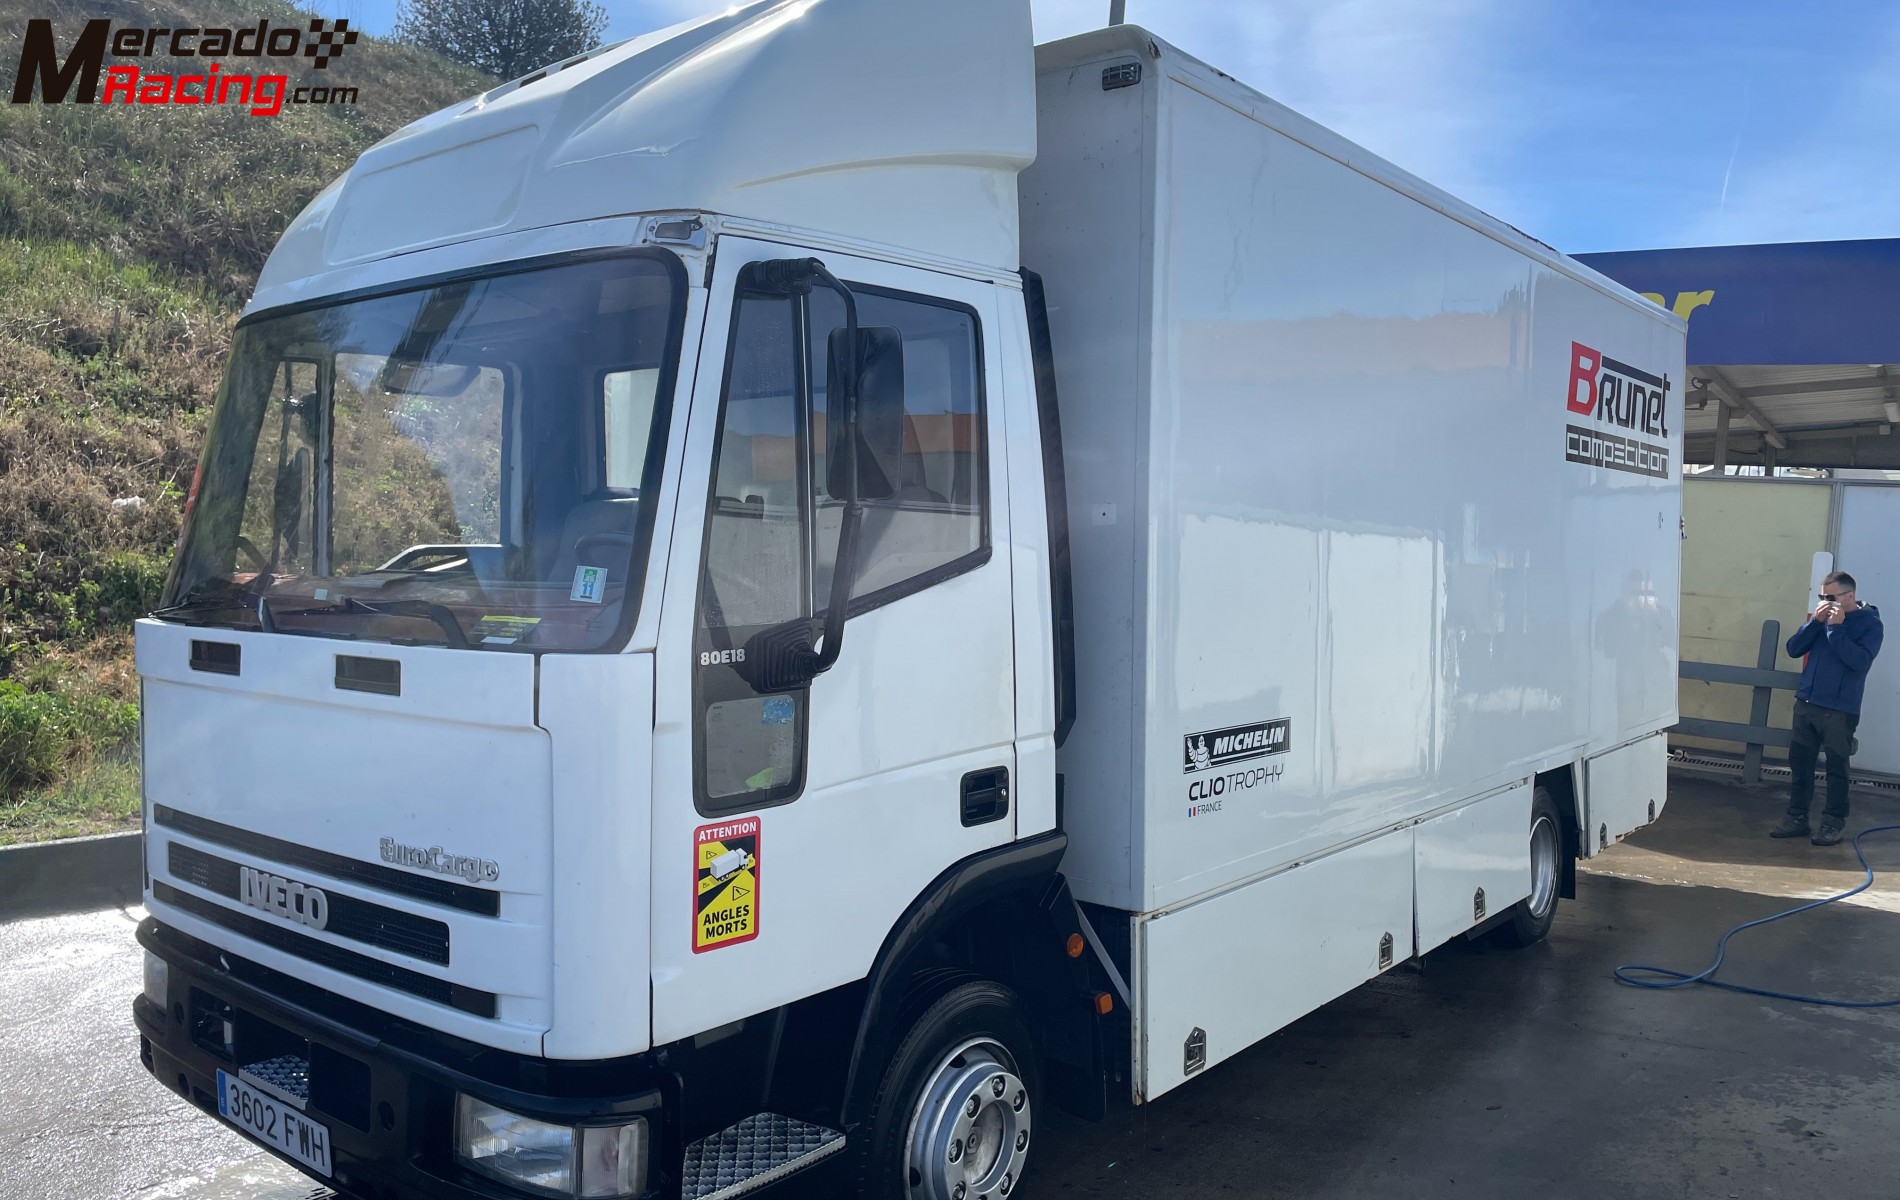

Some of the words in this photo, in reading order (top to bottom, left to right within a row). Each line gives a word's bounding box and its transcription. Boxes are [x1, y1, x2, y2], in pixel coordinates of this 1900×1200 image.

[700, 648, 746, 666] 80E18
[1213, 727, 1285, 756] MICHELIN
[1188, 776, 1226, 801] CLIO
[1226, 763, 1284, 793] TROPHY
[1197, 800, 1222, 814] FRANCE
[699, 820, 757, 842] ATTENTION
[380, 836, 499, 883] EuroCargo
[240, 866, 329, 931] IVECO
[703, 904, 750, 926] ANGLES
[706, 918, 748, 939] MORTS
[230, 1084, 278, 1141] 3602
[284, 1112, 325, 1167] FWH
